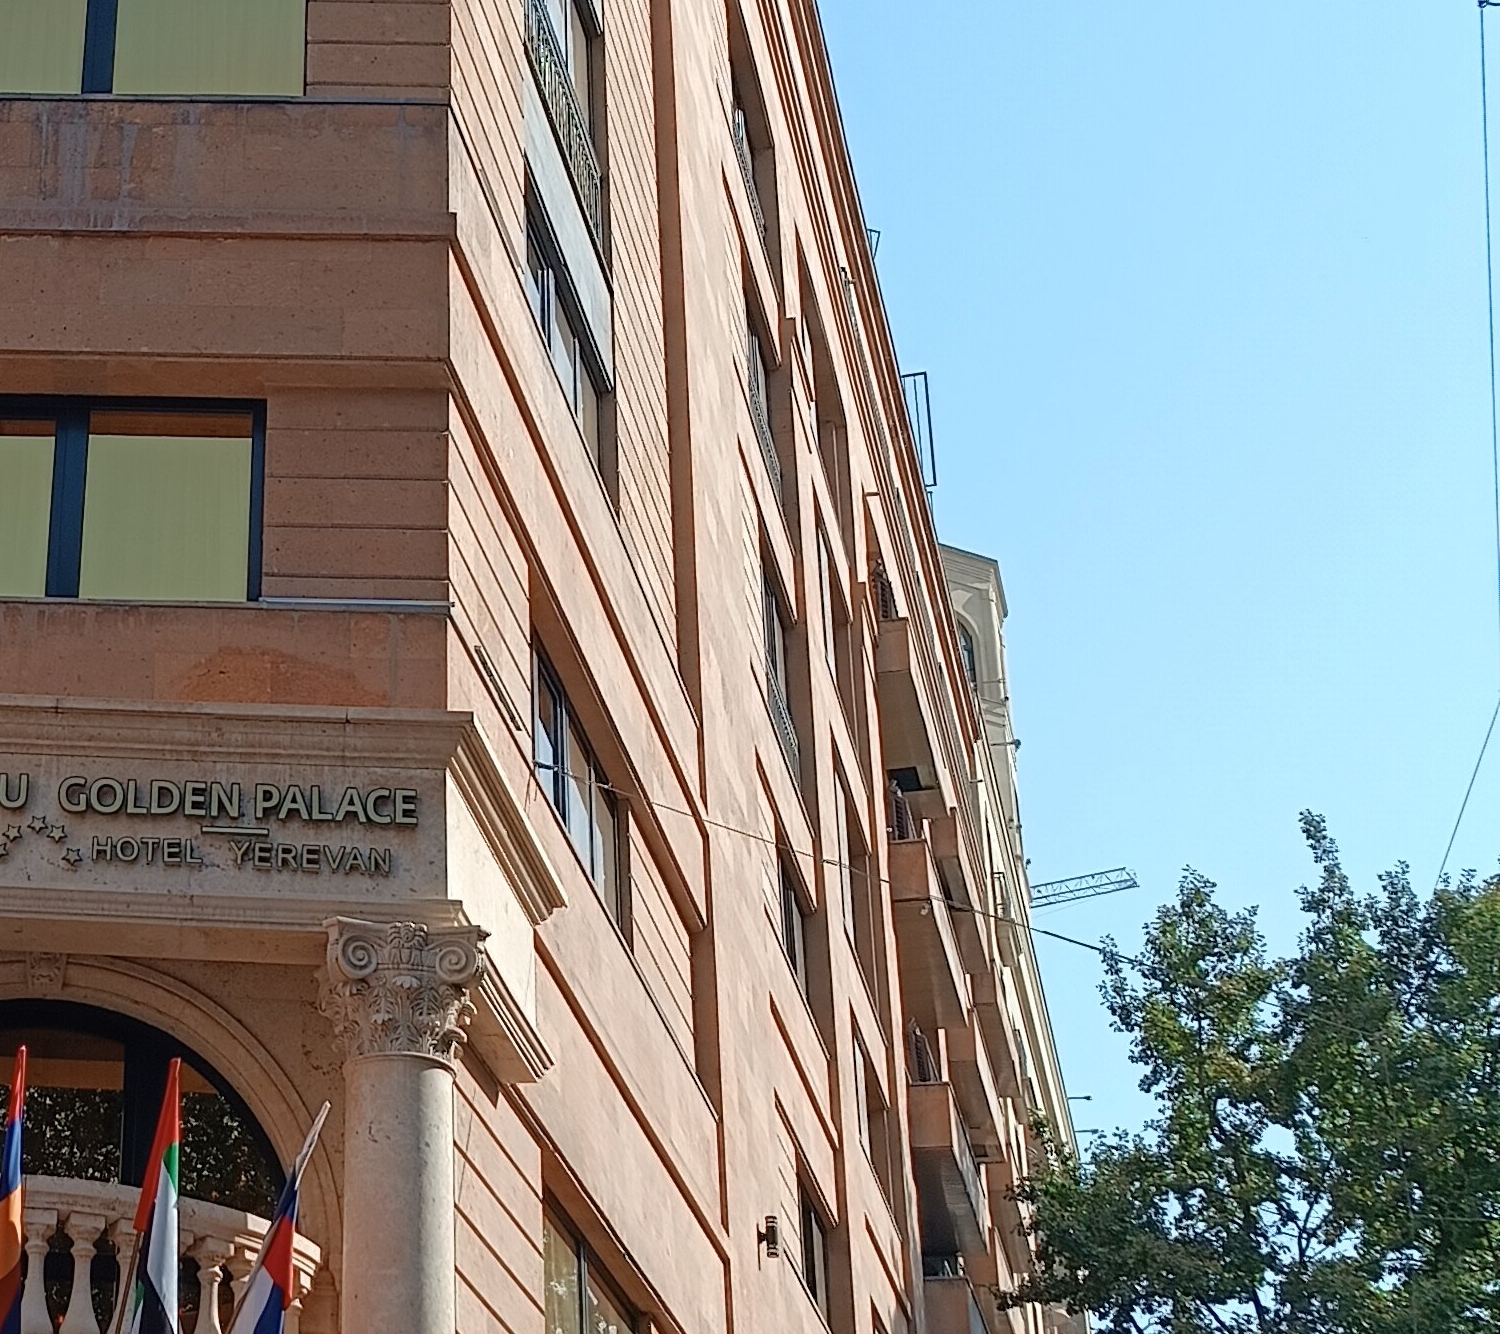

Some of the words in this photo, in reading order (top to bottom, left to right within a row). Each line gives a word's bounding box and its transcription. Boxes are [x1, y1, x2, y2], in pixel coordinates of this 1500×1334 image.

[57, 776, 240, 819] GOLDEN
[254, 783, 419, 825] PALACE
[91, 835, 204, 864] HOTEL
[229, 840, 392, 873] YEREVAN
